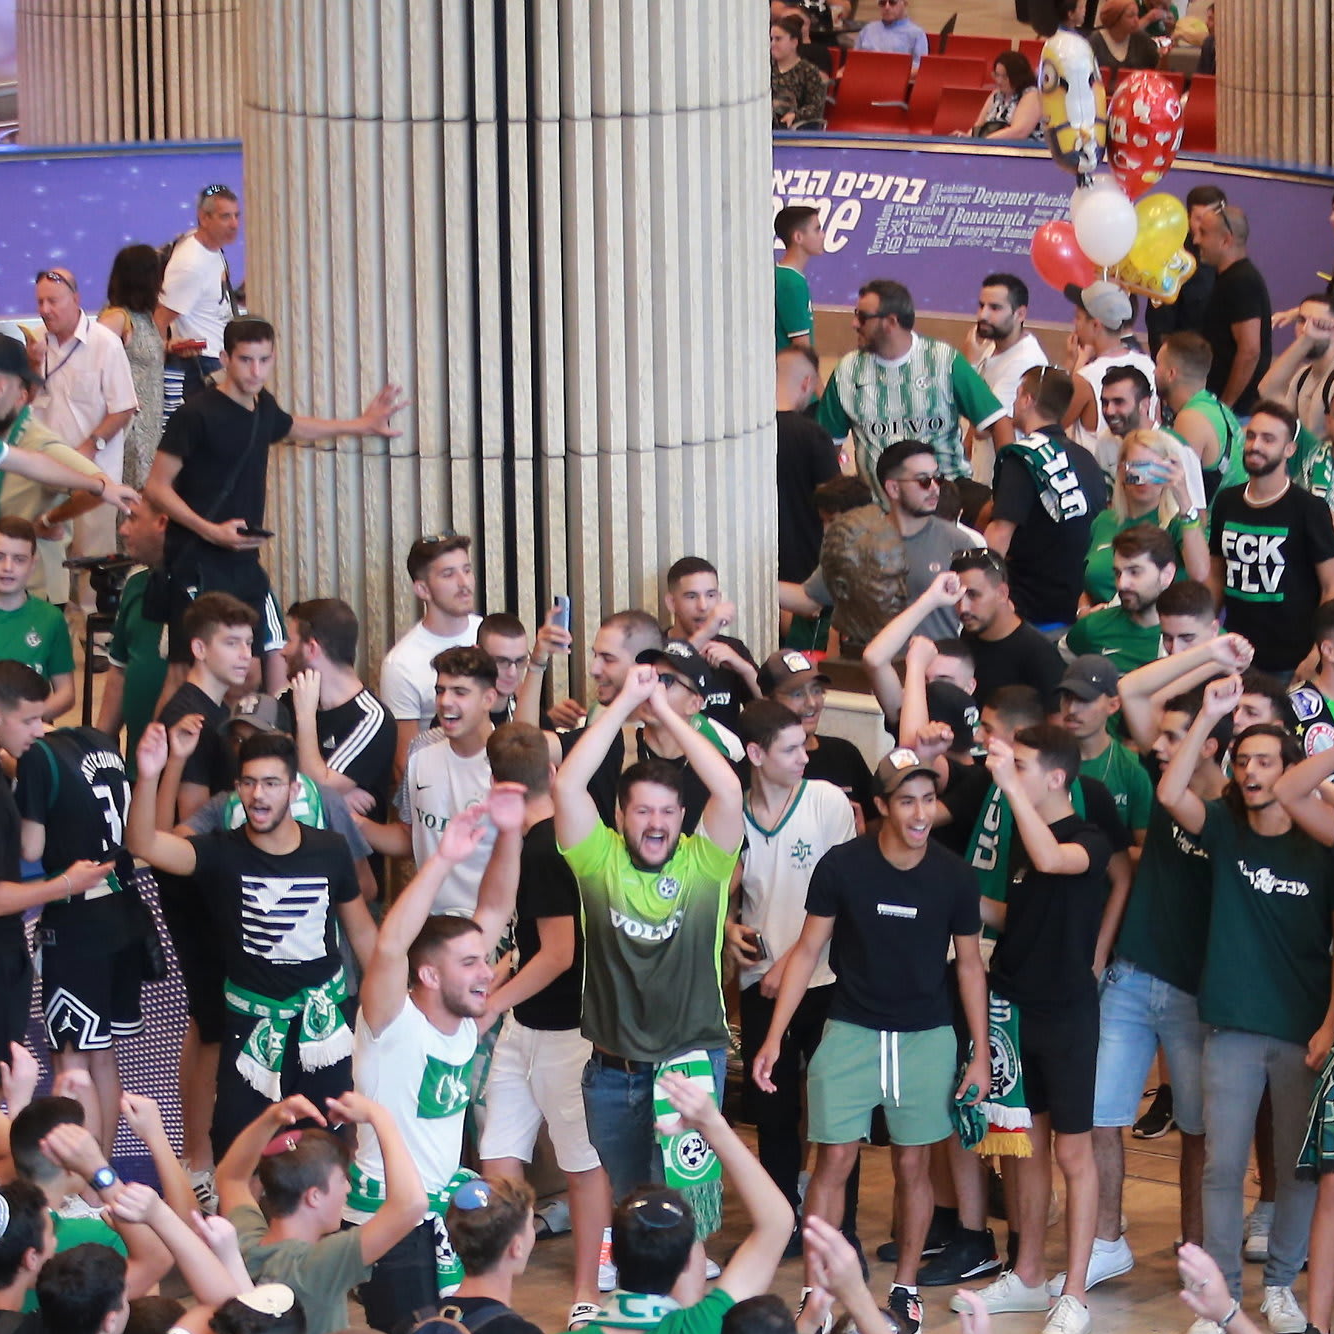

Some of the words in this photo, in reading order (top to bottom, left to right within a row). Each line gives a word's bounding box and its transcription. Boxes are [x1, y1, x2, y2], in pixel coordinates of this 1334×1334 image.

[772, 168, 832, 197] הבא
[831, 170, 928, 206] ברוכים
[973, 186, 1035, 208] Degemer
[870, 416, 944, 438] OLVO
[1221, 529, 1288, 565] FCK
[1225, 560, 1285, 594] TLV
[415, 805, 453, 834] VOL
